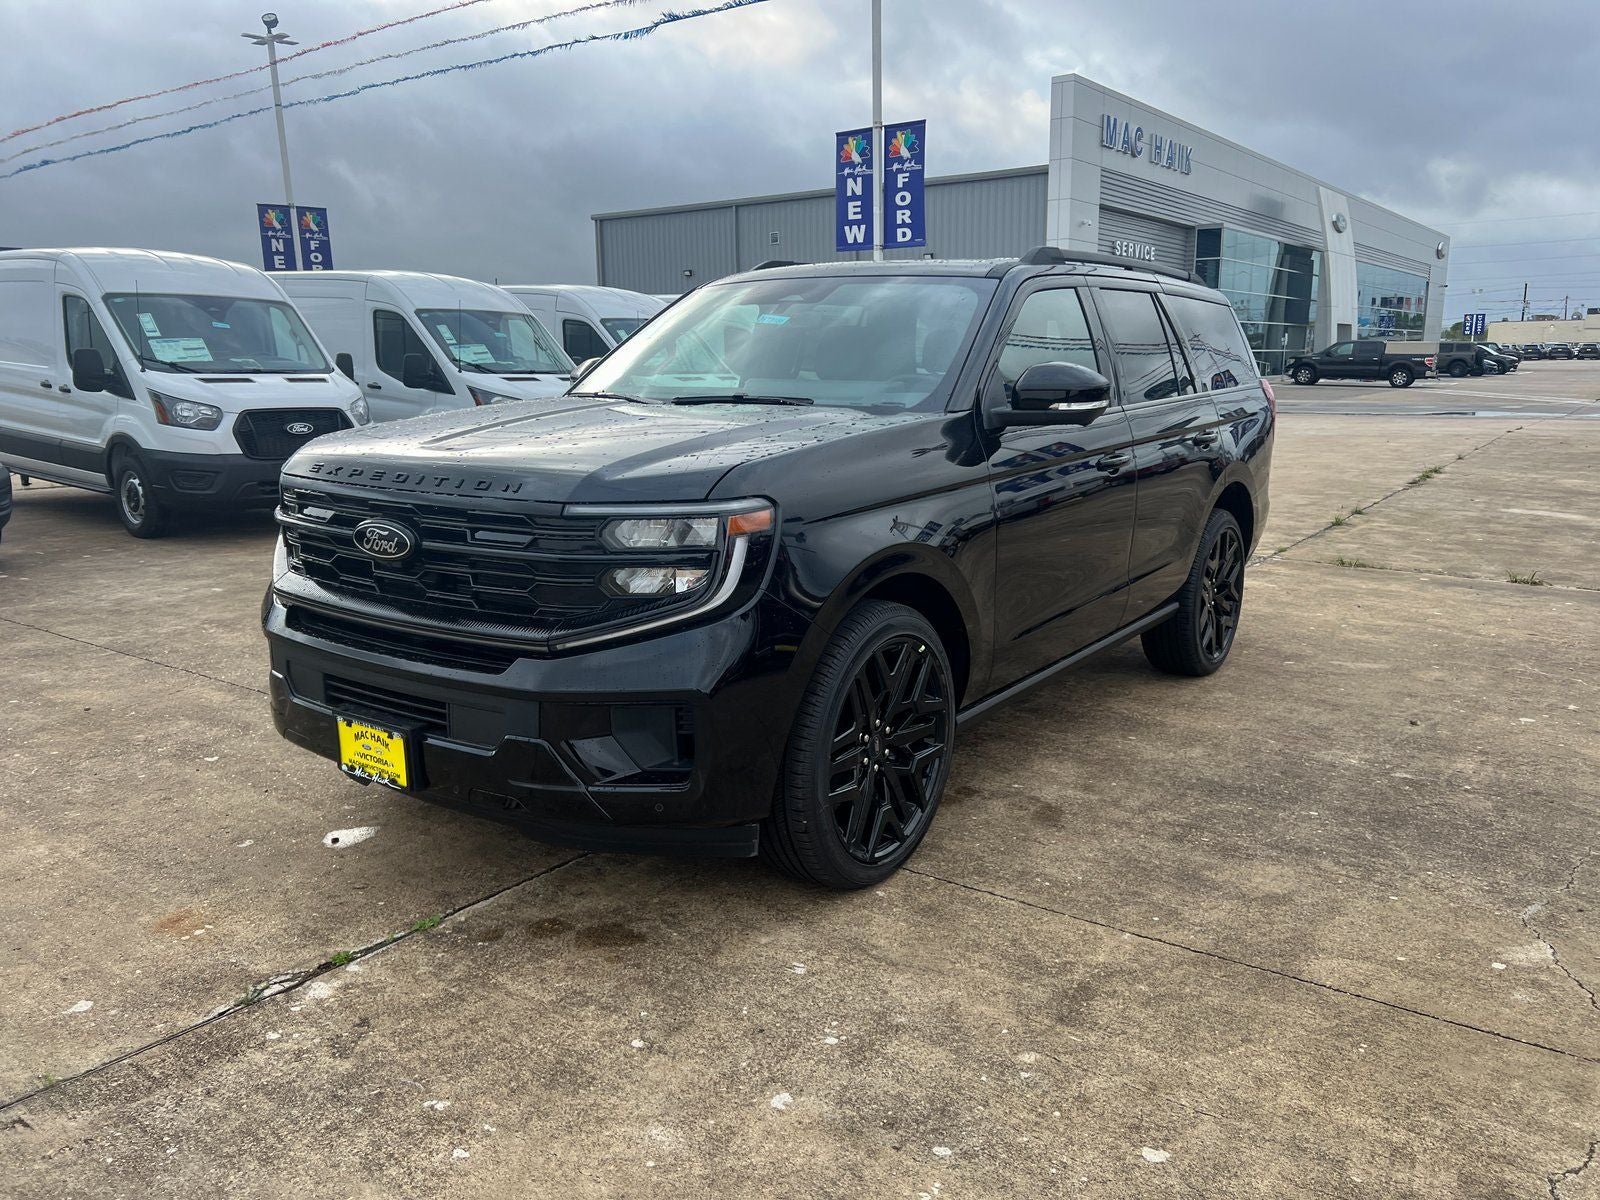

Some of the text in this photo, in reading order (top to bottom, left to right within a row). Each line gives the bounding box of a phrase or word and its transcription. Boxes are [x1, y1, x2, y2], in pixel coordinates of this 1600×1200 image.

[1102, 114, 1193, 175] MAC HAIK
[844, 177, 866, 244] NEW
[895, 173, 912, 243] FORD
[271, 238, 286, 269] NE
[1115, 240, 1156, 261] SERVICE
[292, 424, 309, 432] Ford
[308, 461, 524, 495] EXPEDITION
[363, 526, 399, 554] Ford
[354, 730, 370, 742] MAC
[370, 732, 391, 752] HAIK
[359, 751, 390, 768] VICTORIA
